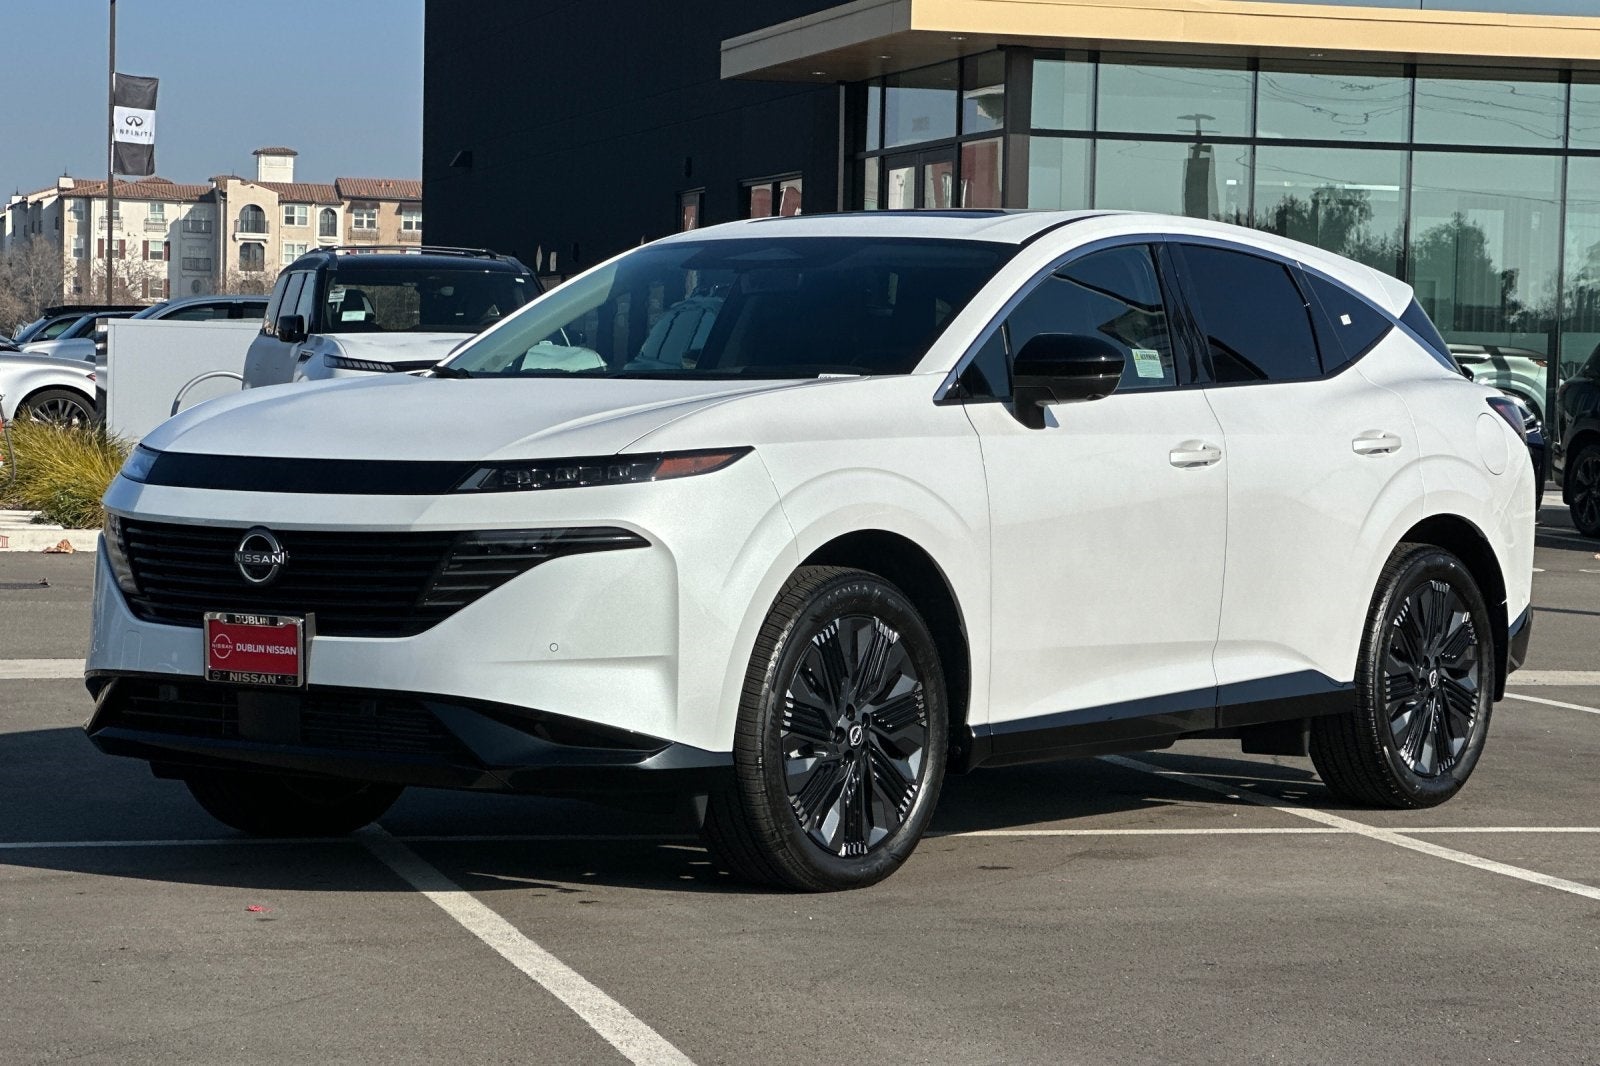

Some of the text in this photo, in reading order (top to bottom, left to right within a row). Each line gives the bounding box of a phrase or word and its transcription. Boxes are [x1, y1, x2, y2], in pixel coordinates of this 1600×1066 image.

[115, 128, 152, 137] INFINITI
[234, 552, 281, 564] NISSAN
[234, 615, 270, 625] DUBLIN
[236, 643, 297, 656] DUBLIN NISSAN
[229, 672, 277, 684] NISSAN
